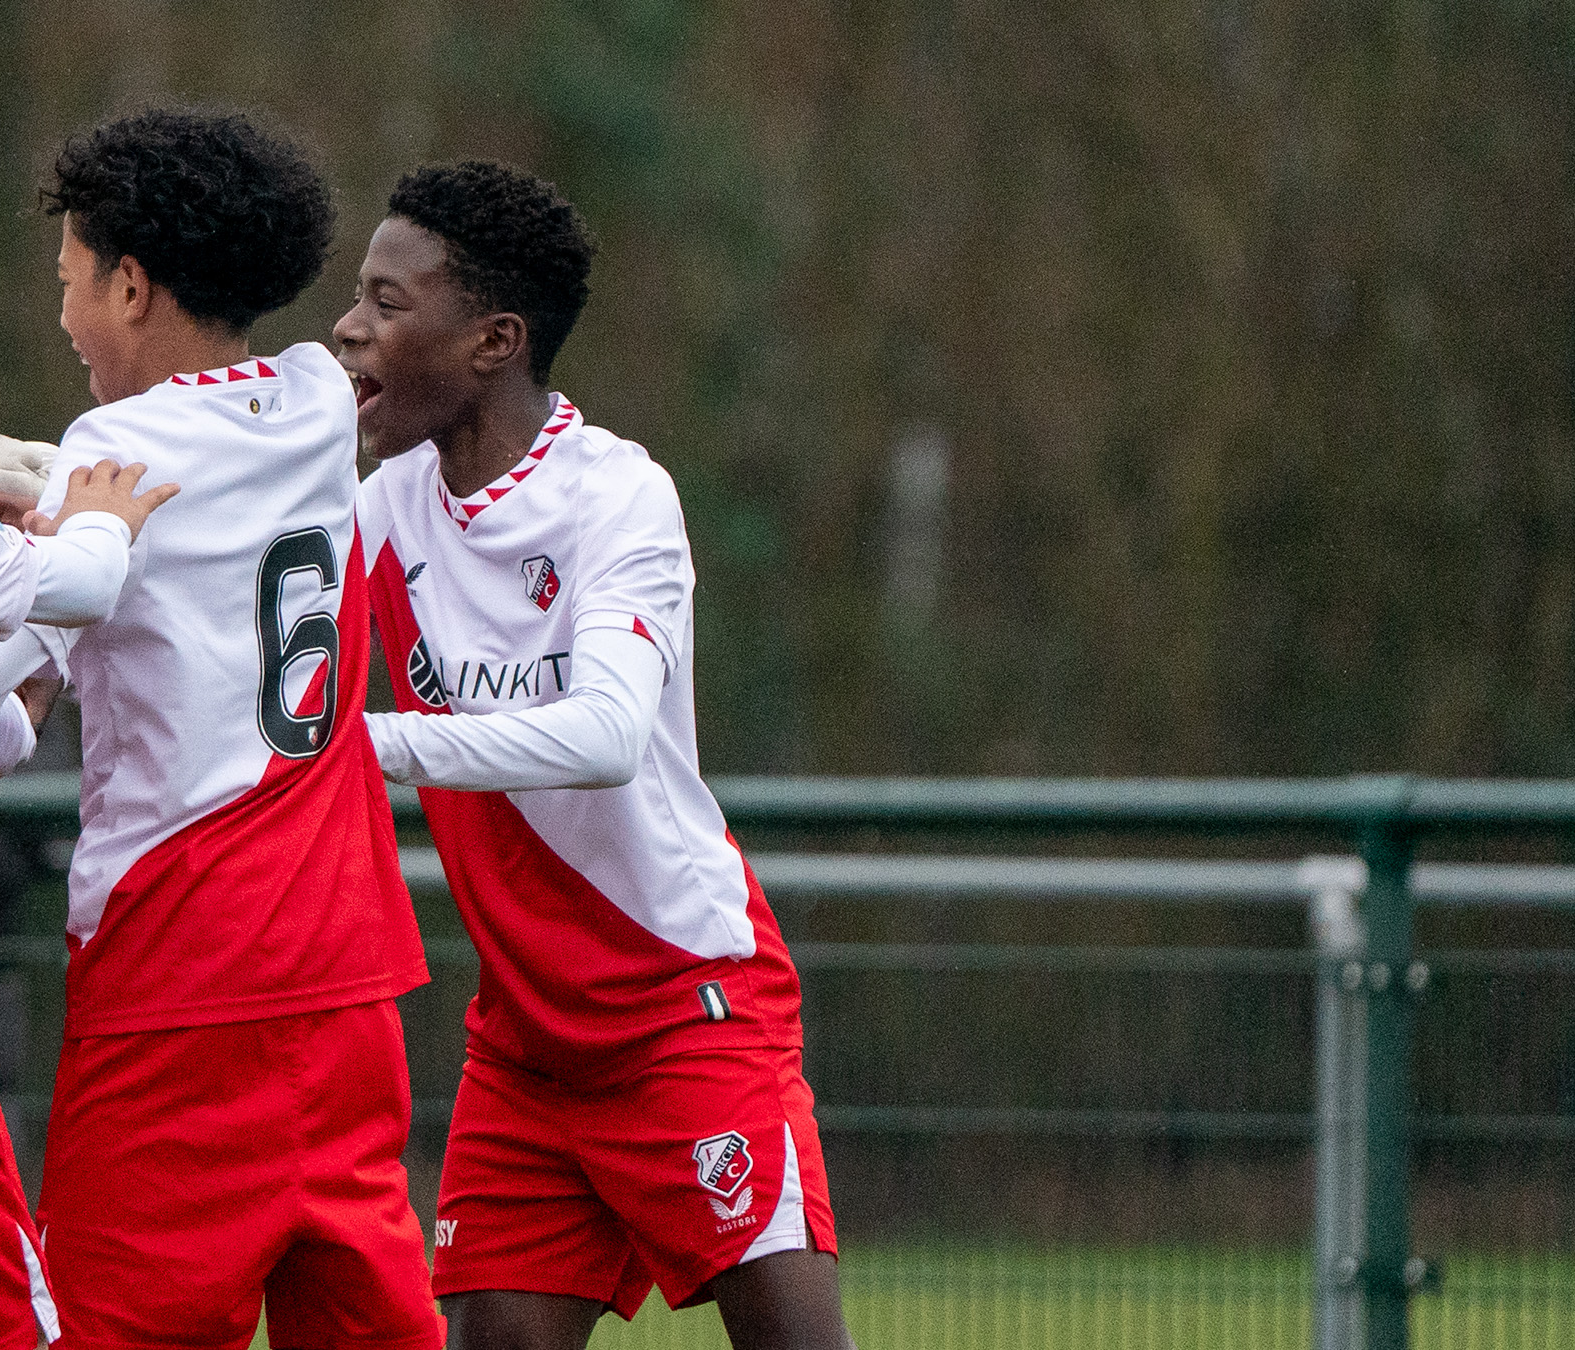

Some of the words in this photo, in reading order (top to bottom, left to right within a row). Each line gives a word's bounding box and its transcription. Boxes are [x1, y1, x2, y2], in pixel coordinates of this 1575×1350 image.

[530, 558, 553, 603] UTRECHT
[255, 525, 340, 759] 6
[439, 651, 570, 700] LINKIT
[707, 1137, 742, 1187] UTRECHT
[716, 1215, 757, 1233] CASTORE
